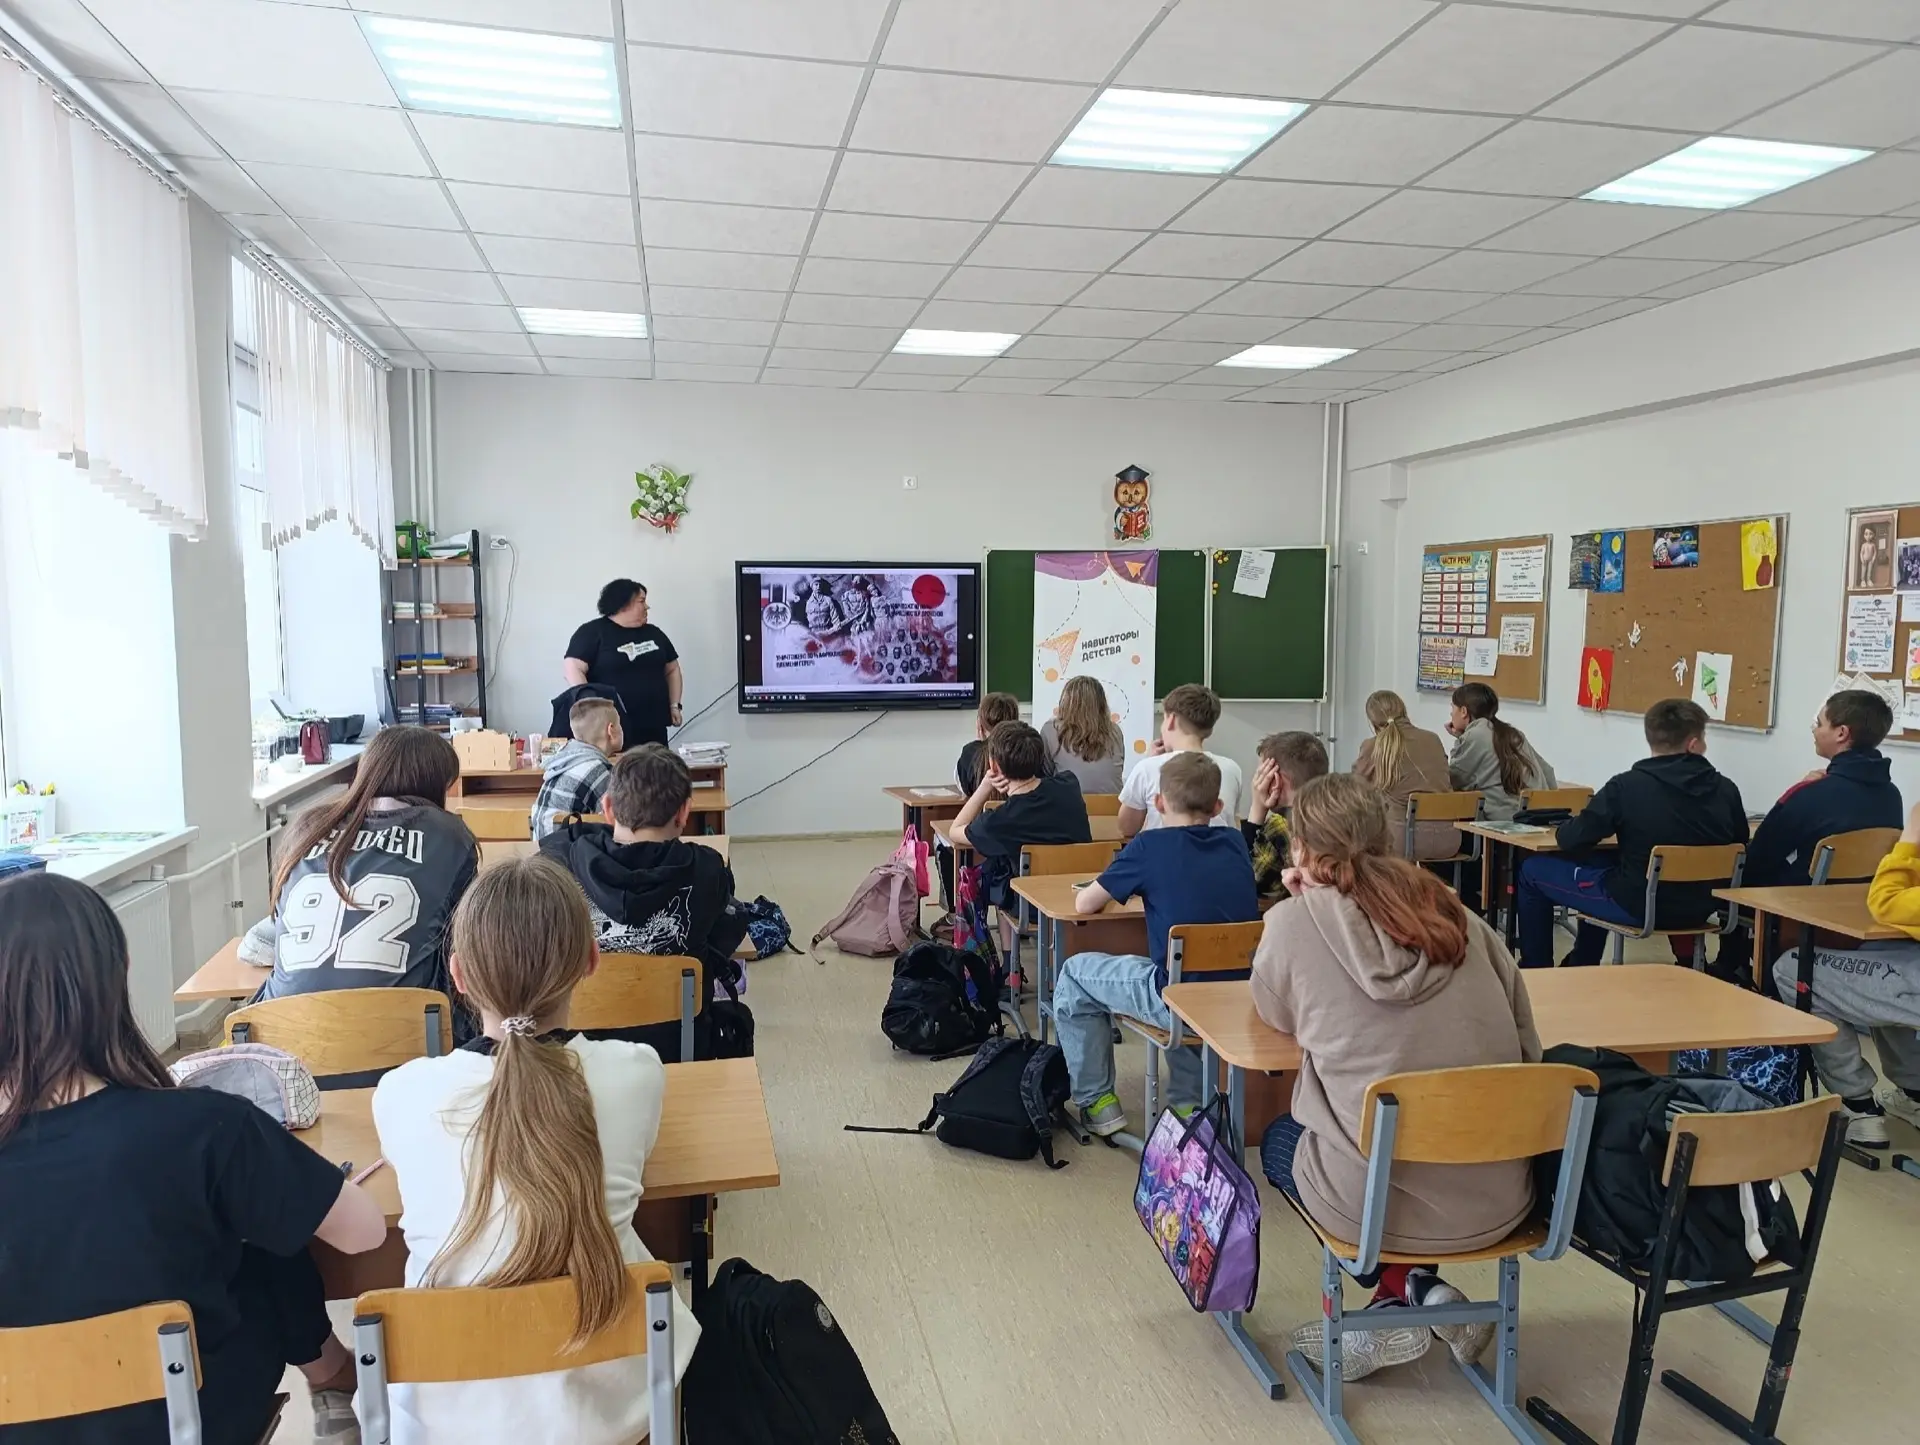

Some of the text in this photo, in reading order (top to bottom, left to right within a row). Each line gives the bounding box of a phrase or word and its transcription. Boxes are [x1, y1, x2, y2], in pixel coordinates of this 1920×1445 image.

[1081, 630, 1139, 650] НАВИГАТОРЫ
[1082, 645, 1121, 662] ДЕТСТВА
[278, 872, 421, 974] 92
